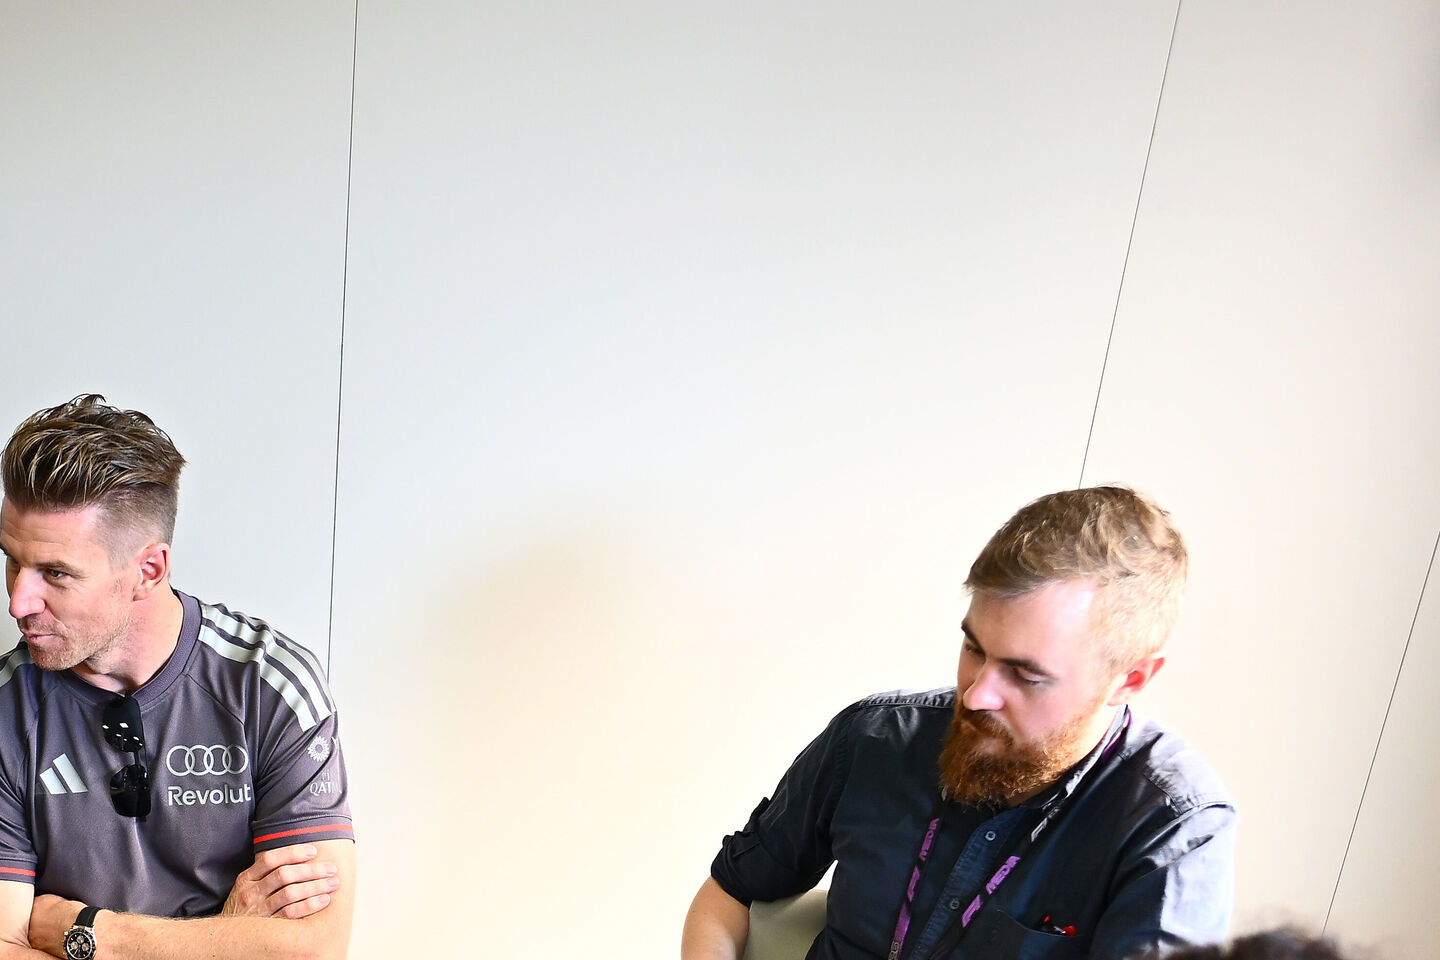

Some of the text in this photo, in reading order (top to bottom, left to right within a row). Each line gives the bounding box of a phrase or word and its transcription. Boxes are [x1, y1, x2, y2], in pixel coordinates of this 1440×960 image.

[168, 784, 251, 806] Revolut
[918, 817, 940, 862] MEDIA
[985, 855, 1020, 895] MEDIA
